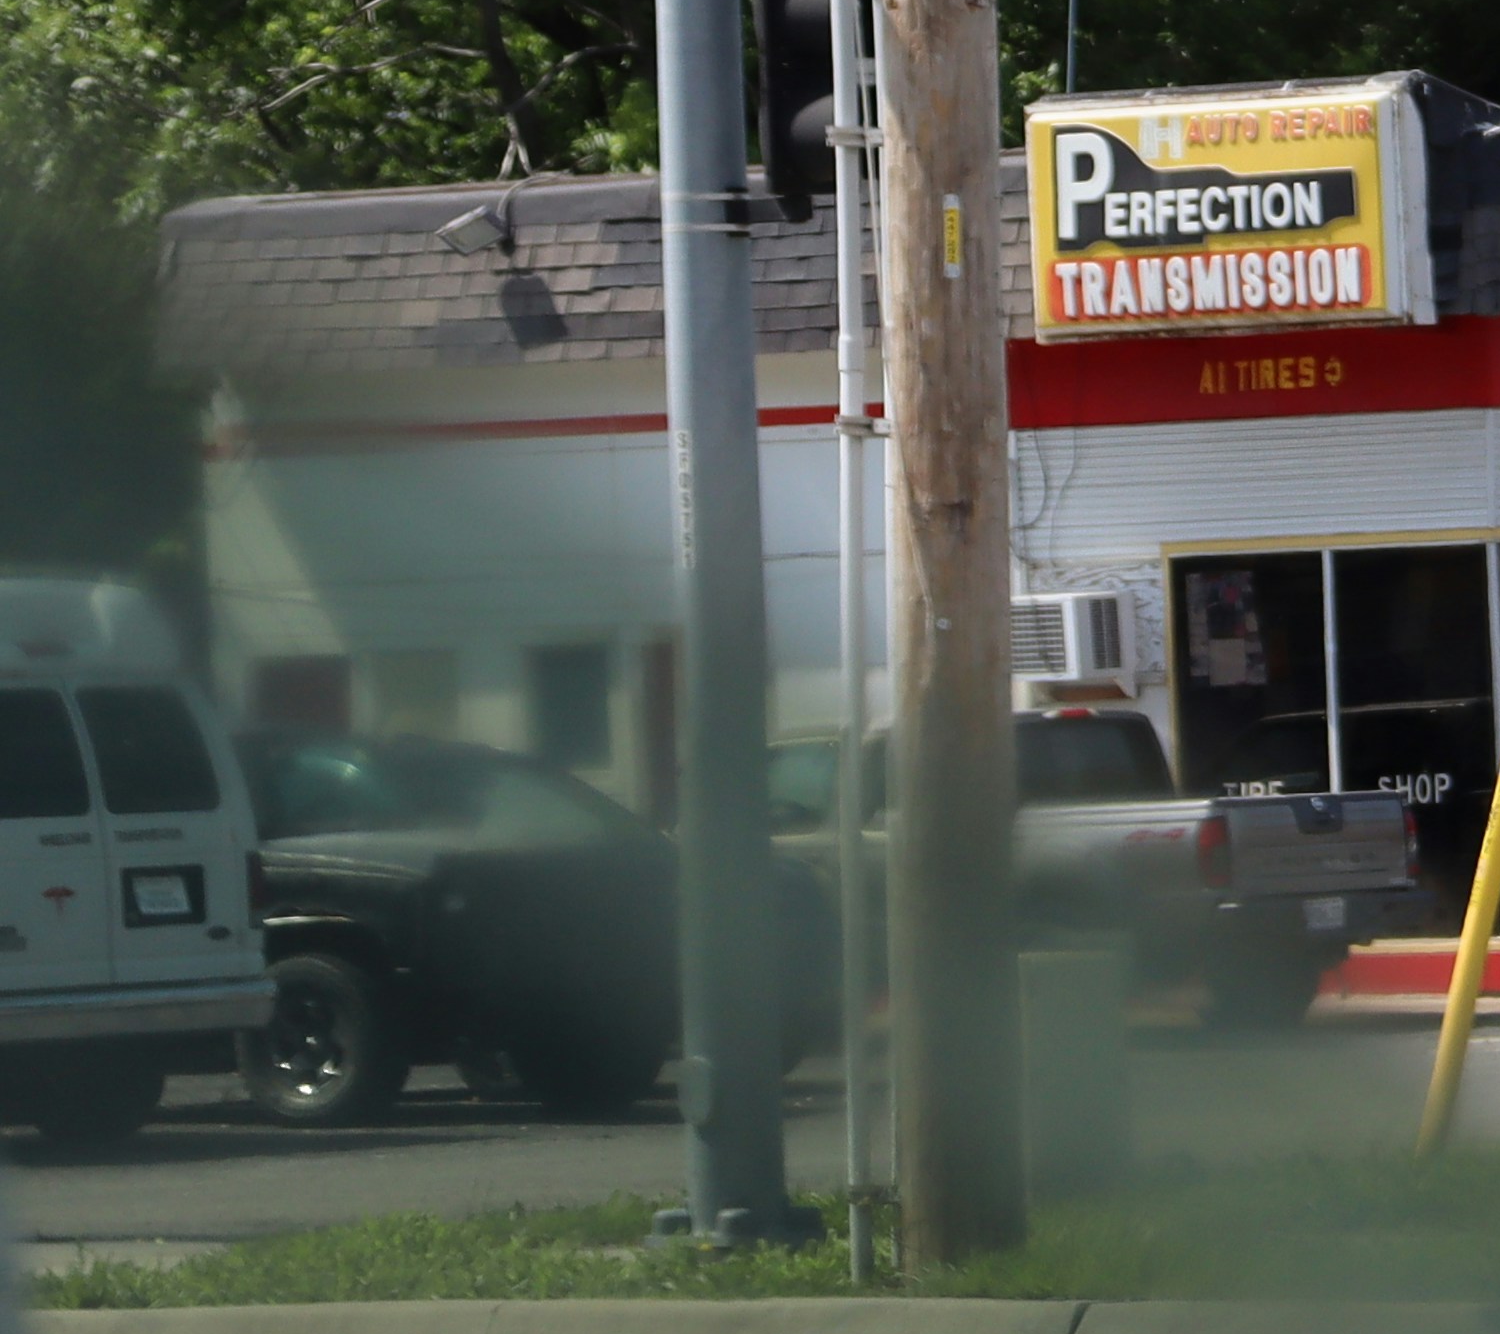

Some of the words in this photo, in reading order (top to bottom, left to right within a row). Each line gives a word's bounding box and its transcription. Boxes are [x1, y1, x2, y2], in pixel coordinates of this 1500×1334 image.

[1186, 112, 1260, 146] AUTO
[1269, 104, 1374, 142] REPAIR
[1054, 245, 1363, 318] TRANSMISSION
[1233, 356, 1316, 392] TIRES
[1376, 771, 1453, 804] SHOP
